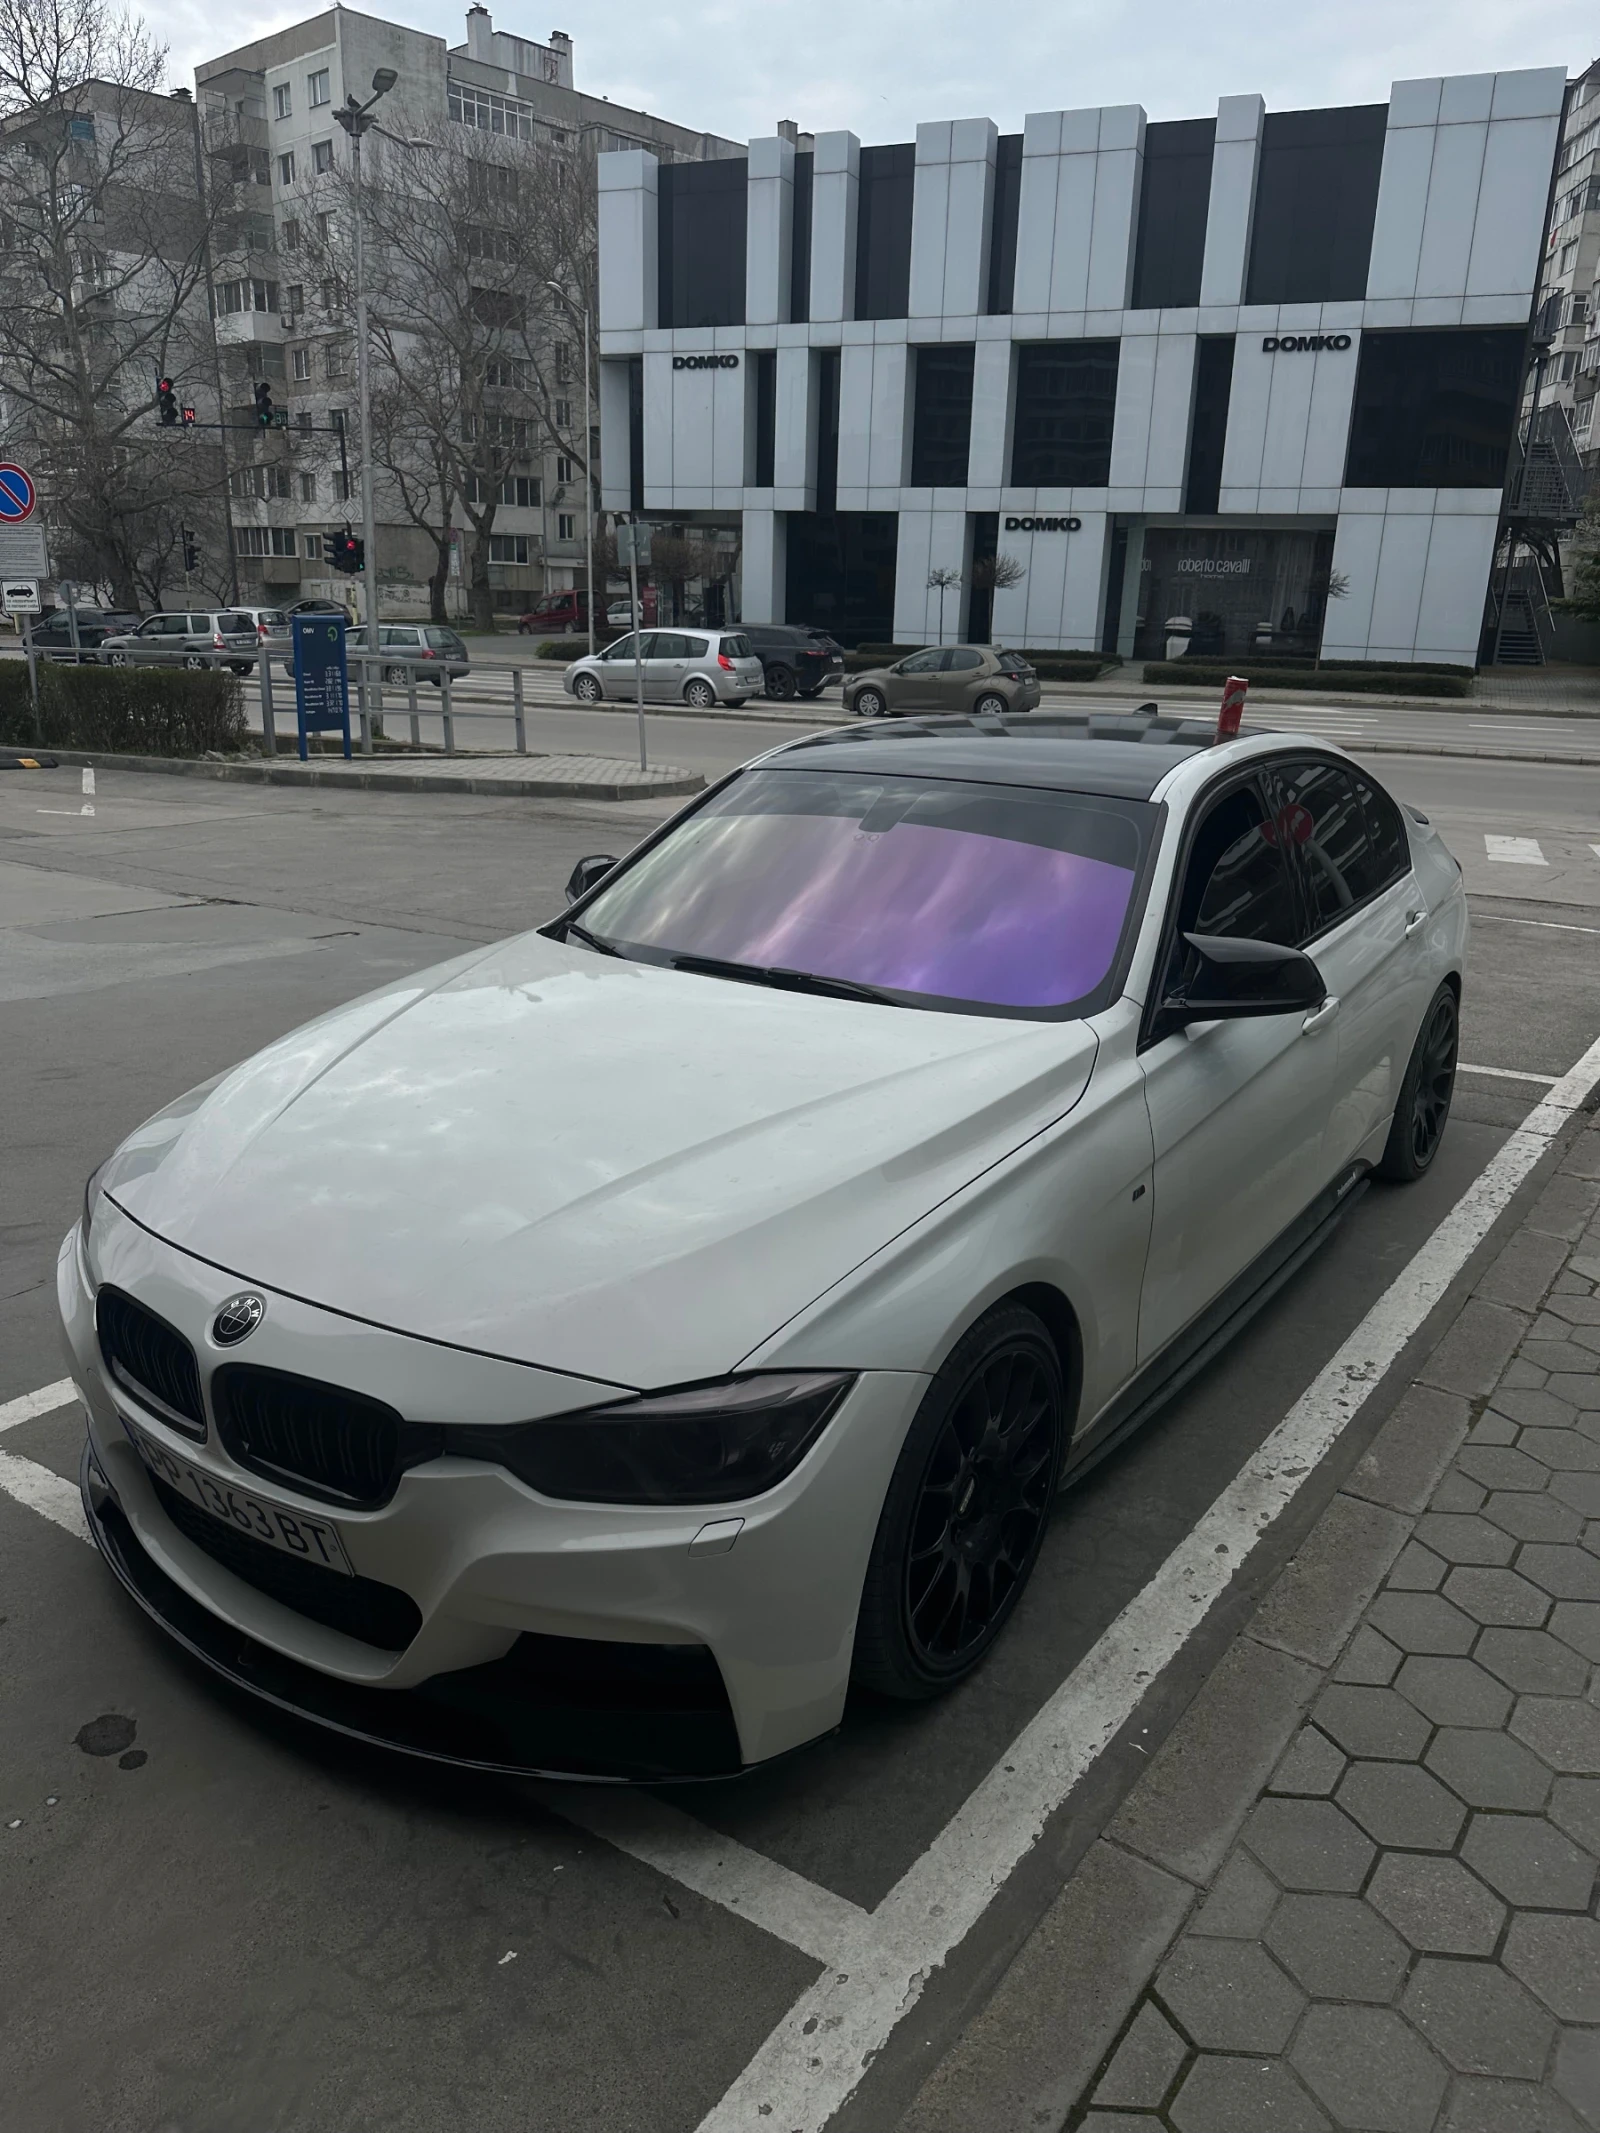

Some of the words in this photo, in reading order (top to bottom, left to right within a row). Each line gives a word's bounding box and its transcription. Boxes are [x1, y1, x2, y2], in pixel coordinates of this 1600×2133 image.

[1262, 334, 1352, 353] DOMKO
[672, 354, 739, 370] DOMKO
[183, 410, 195, 421] 14
[1005, 517, 1082, 532] DOMKO
[1178, 558, 1215, 573] roberto
[1216, 559, 1251, 573] cavalli
[302, 627, 315, 635] OMV
[230, 1298, 261, 1318] BMW
[186, 1470, 275, 1539] 1363
[273, 1511, 331, 1563] BT
